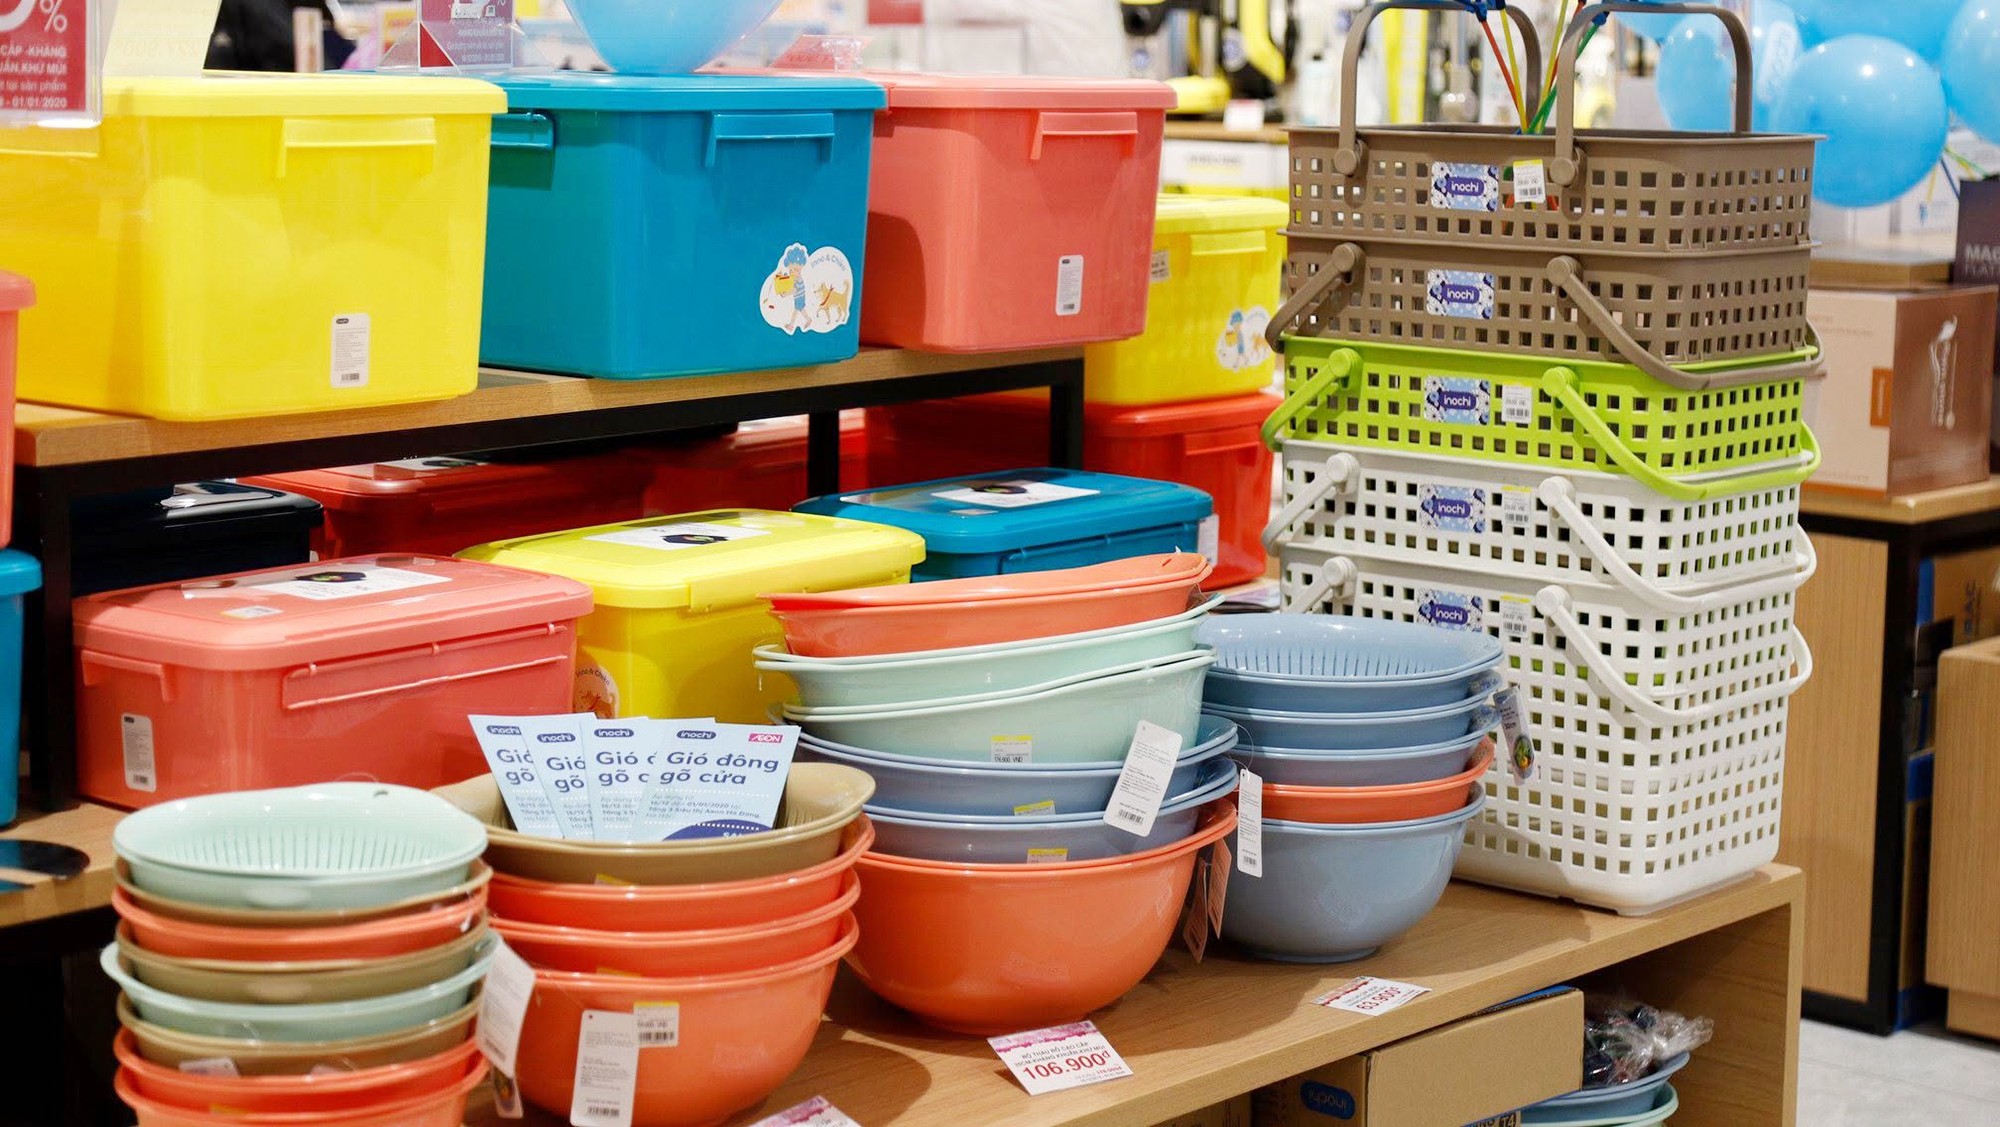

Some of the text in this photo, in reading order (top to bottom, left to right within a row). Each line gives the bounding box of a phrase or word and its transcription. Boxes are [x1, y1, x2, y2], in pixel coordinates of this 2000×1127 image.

[1450, 181, 1479, 193] inochi
[1446, 288, 1475, 300] inochi
[1443, 395, 1471, 407] inochi
[1437, 504, 1466, 515] inochi
[1435, 607, 1463, 621] inochi
[541, 733, 572, 743] inochi
[598, 729, 631, 738] inochi
[680, 730, 713, 740] inochi
[546, 756, 586, 771] Gió
[596, 751, 639, 765] Gió
[667, 752, 708, 765] Gió
[716, 753, 779, 773] đông
[506, 768, 534, 785] gõ
[554, 774, 585, 793] gõ
[598, 769, 629, 787] gõ
[660, 769, 691, 785] gõ
[699, 770, 747, 785] cửa
